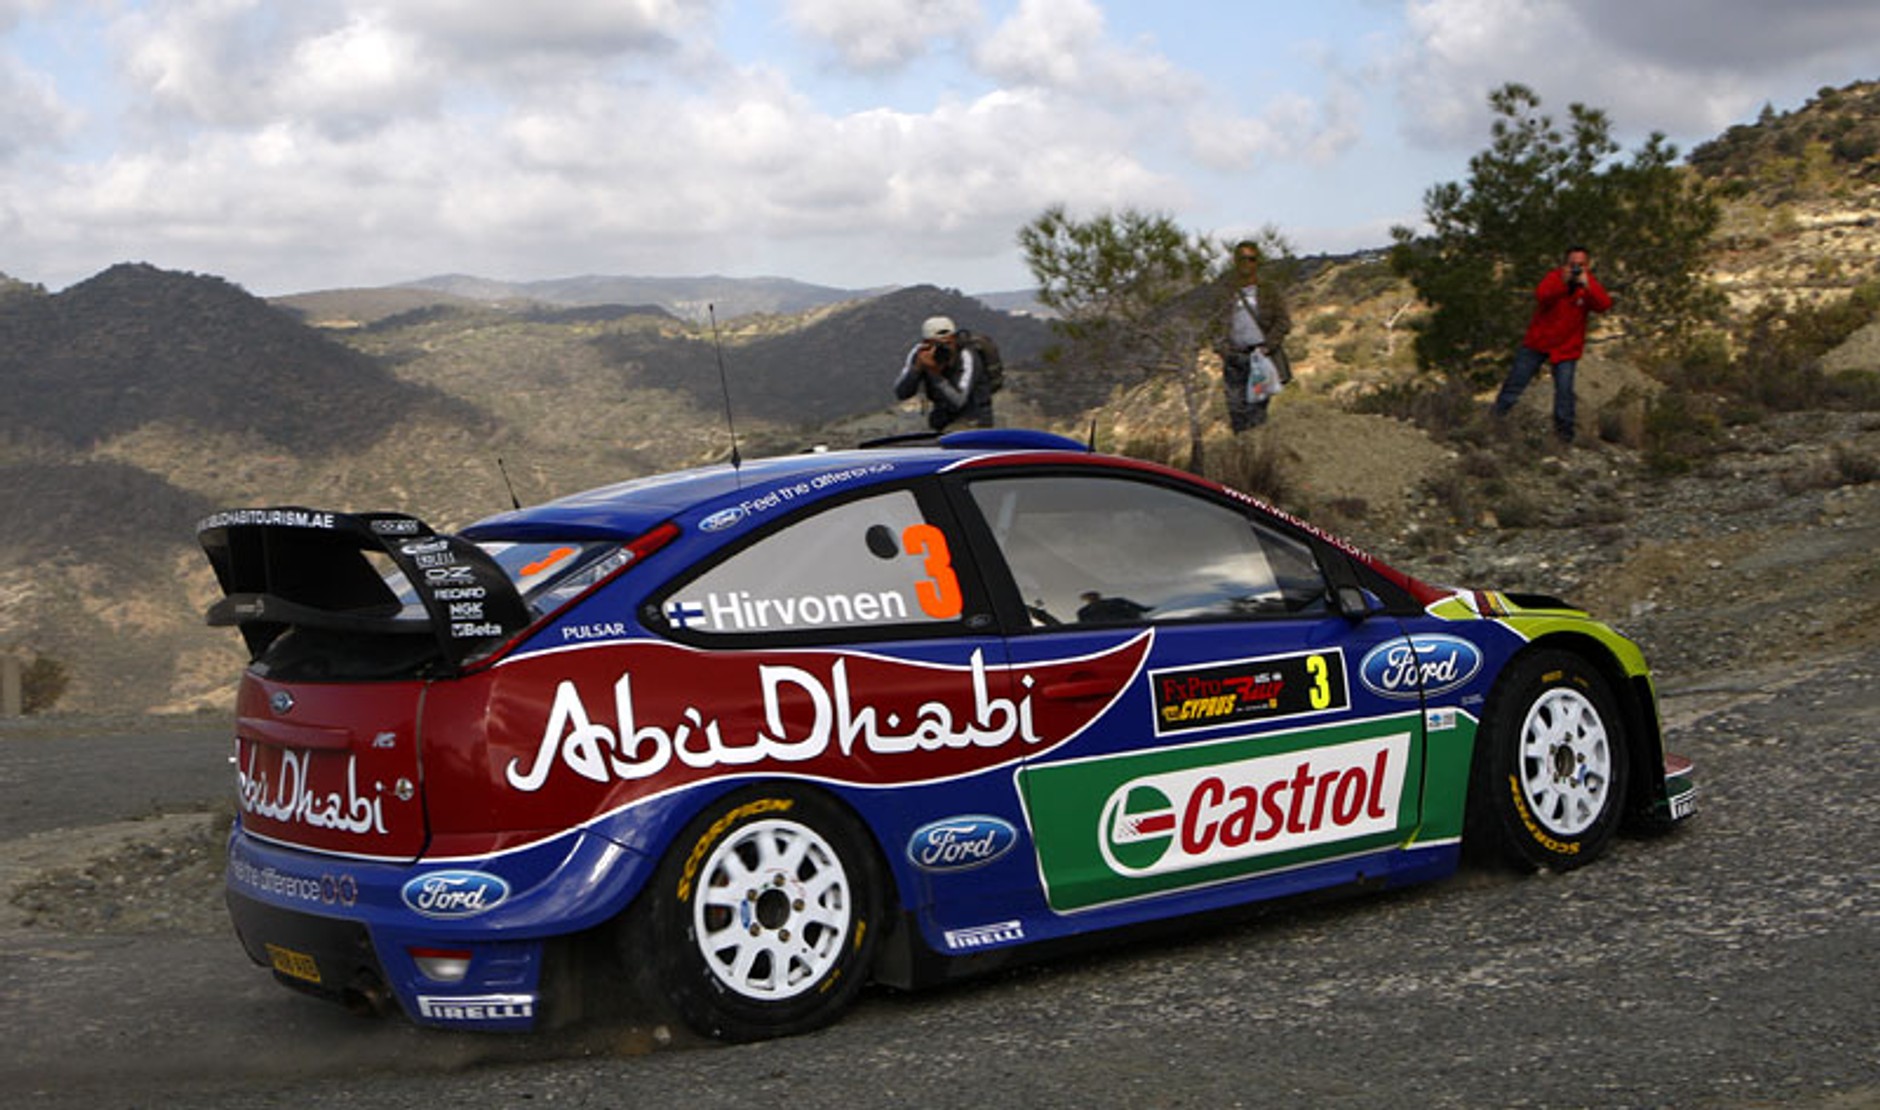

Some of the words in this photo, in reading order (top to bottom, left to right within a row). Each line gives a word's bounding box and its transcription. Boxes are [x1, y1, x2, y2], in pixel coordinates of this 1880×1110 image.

[741, 490, 781, 516] Feel
[777, 480, 810, 501] the
[902, 524, 963, 618] 3
[434, 587, 485, 600] RECARO
[450, 602, 483, 616] NGK
[707, 591, 907, 629] Hirvonen
[465, 623, 502, 637] Beta
[561, 622, 627, 640] PULSAR
[1307, 655, 1331, 709] 3
[1382, 645, 1458, 690] Ford
[1162, 677, 1222, 702] FxPro
[1182, 694, 1237, 720] CYPRUS
[1181, 748, 1389, 855] Castrol
[677, 799, 794, 901] SCORPION
[921, 826, 995, 863] Ford
[418, 878, 488, 909] Ford
[944, 921, 1024, 949] PIRELLI
[416, 995, 535, 1018] PIRELLI
